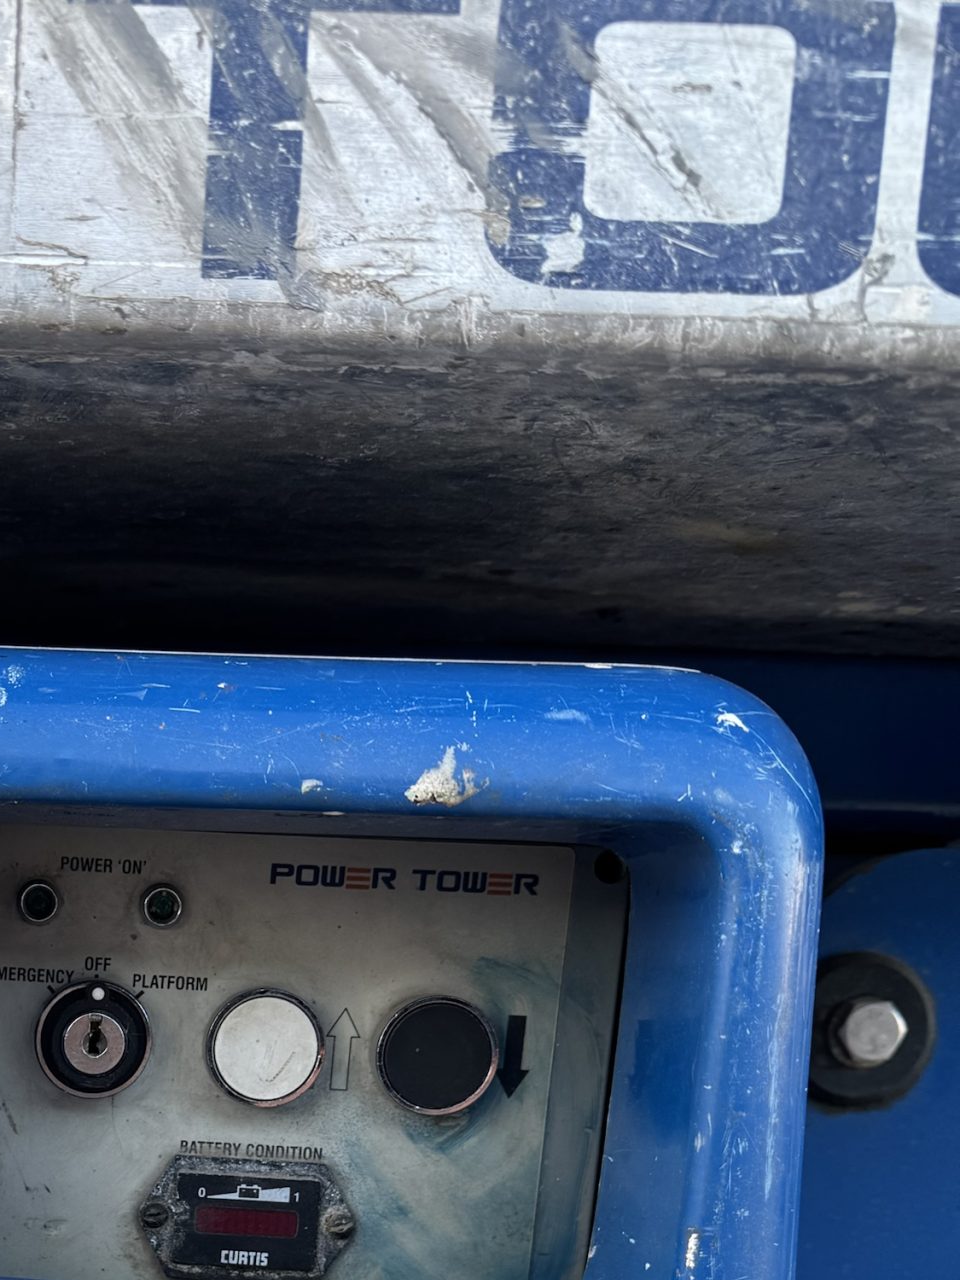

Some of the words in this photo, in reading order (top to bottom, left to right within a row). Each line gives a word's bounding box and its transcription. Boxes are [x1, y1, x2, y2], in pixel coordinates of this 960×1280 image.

[60, 856, 113, 873] POWER
[269, 862, 397, 890] POWER
[412, 868, 540, 896] TOWER
[84, 956, 112, 972] OFF
[132, 974, 208, 991] PLATFORM
[179, 1139, 241, 1157] BATTERY
[246, 1143, 323, 1161] CONDITION
[220, 1249, 269, 1267] CURTIS
